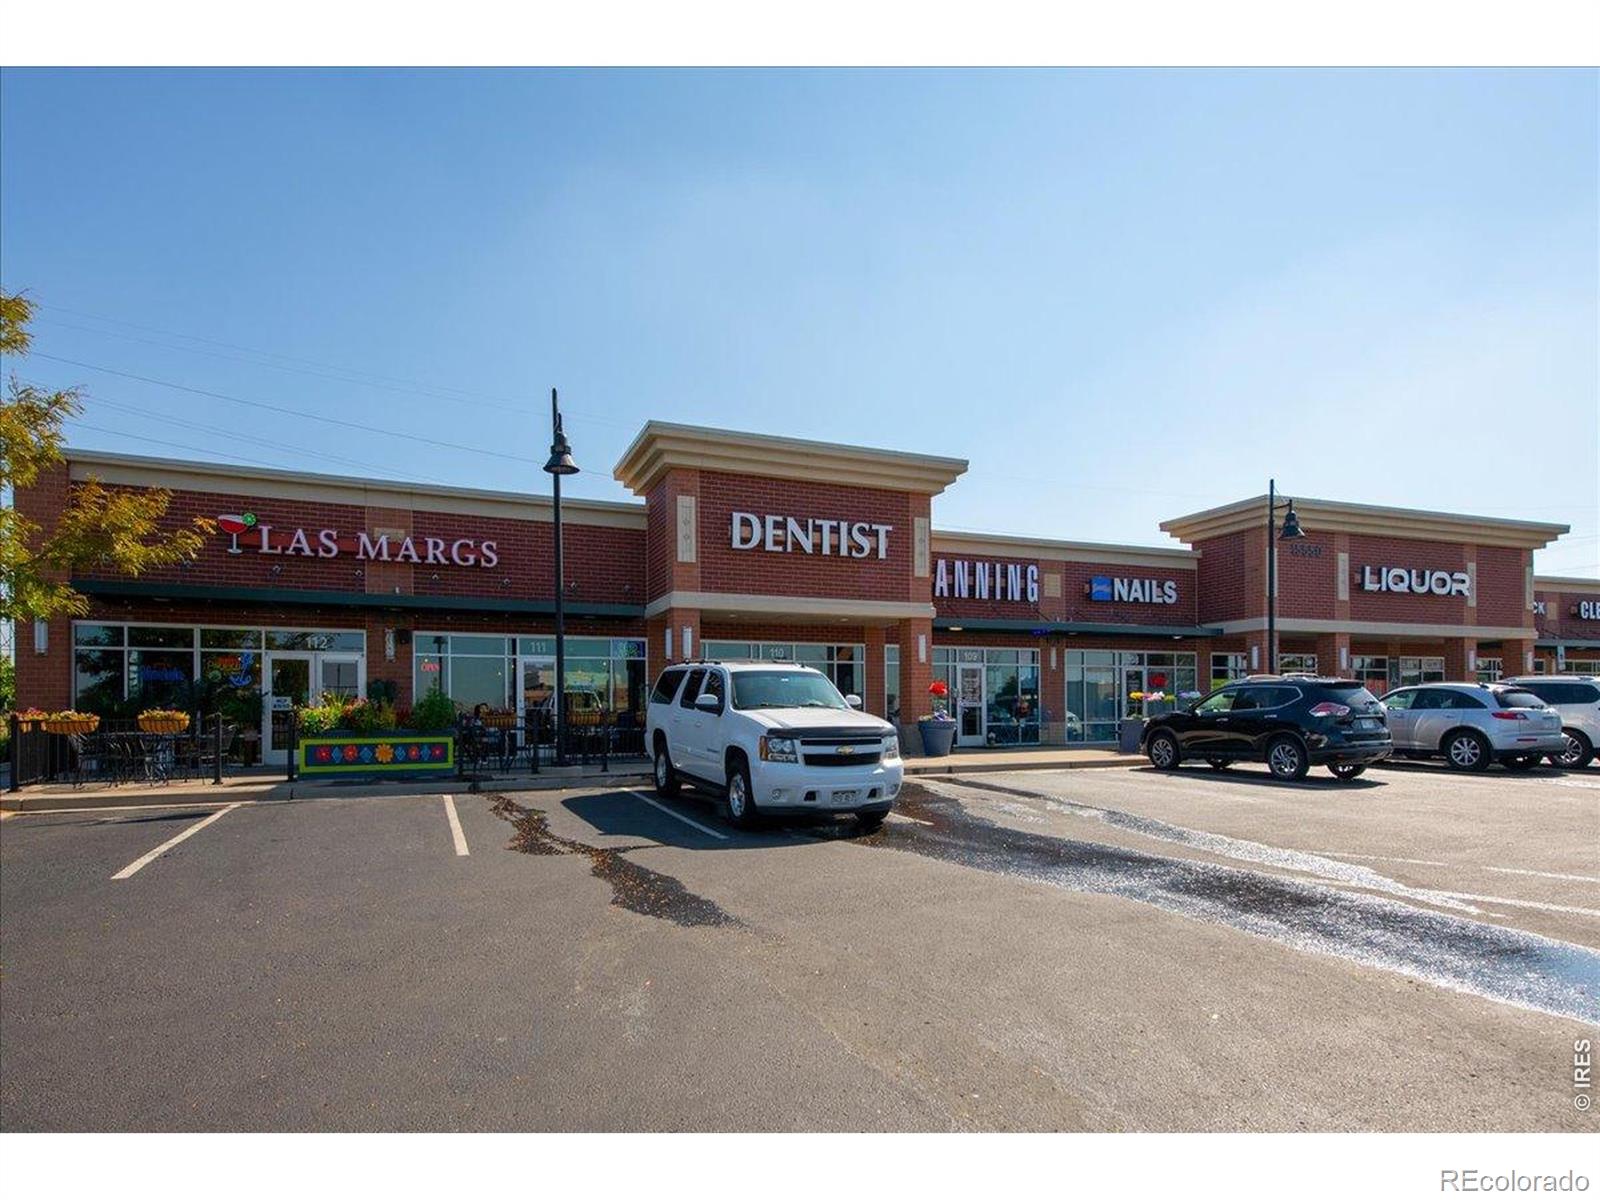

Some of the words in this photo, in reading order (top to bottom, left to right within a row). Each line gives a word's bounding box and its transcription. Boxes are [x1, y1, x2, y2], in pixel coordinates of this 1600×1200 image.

[257, 525, 339, 558] LAS
[356, 532, 499, 568] MARGS
[731, 511, 893, 560] DENTIST
[935, 559, 1039, 602] ANNING
[1113, 577, 1178, 604] NAILS
[1364, 566, 1471, 597] LIQUOR
[1580, 601, 1600, 619] CLE
[306, 635, 328, 649] 112
[529, 641, 546, 654] 111
